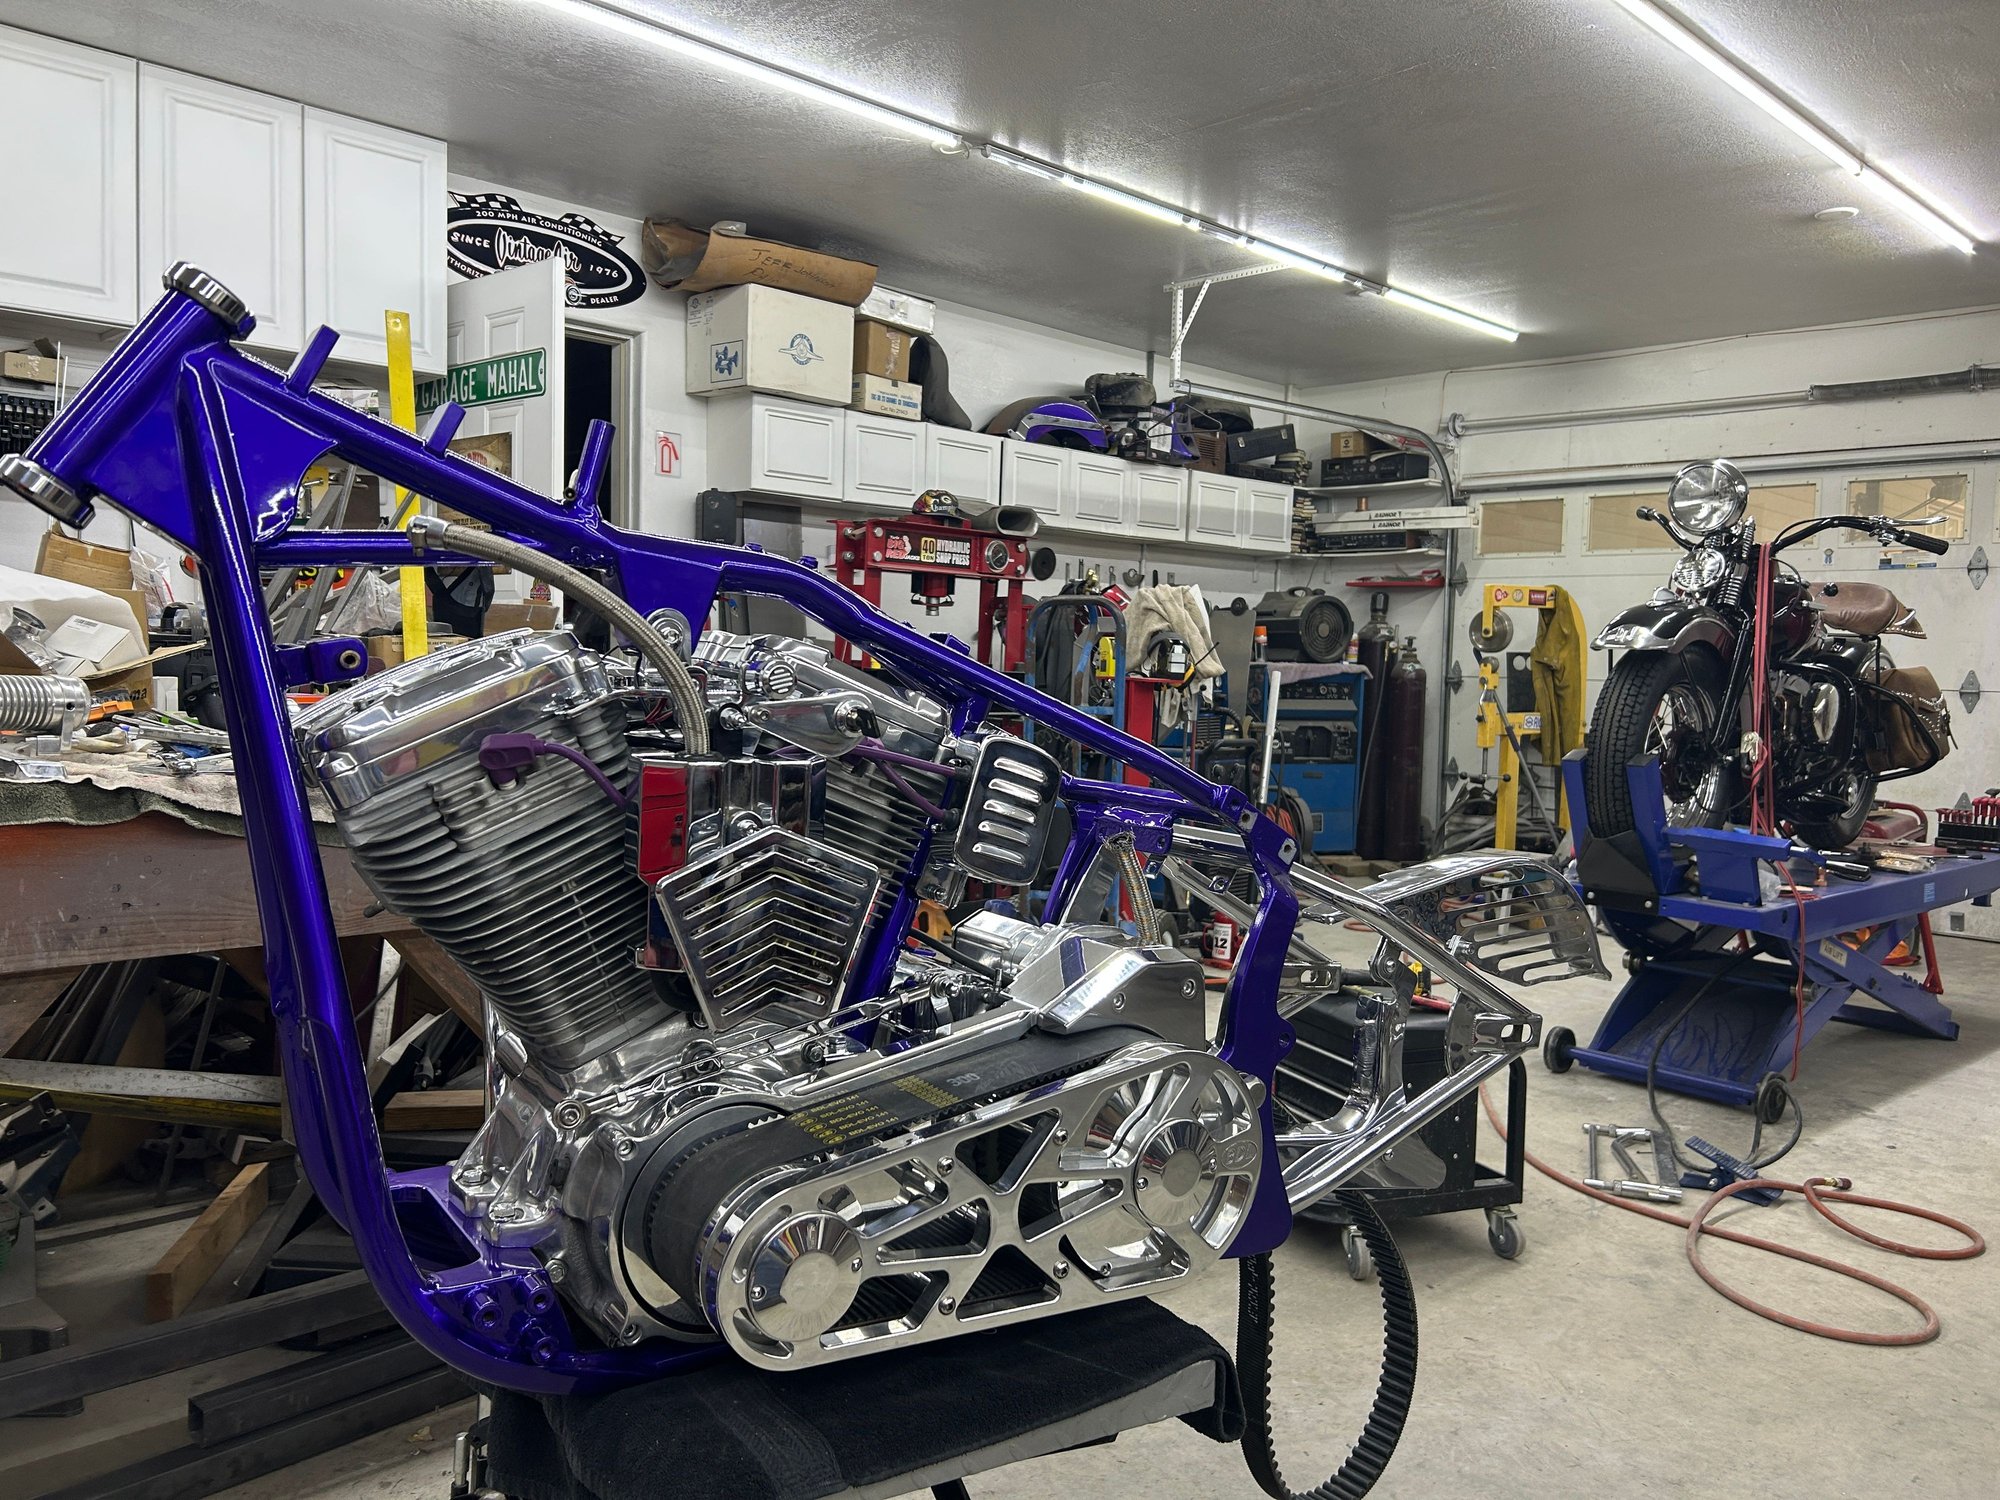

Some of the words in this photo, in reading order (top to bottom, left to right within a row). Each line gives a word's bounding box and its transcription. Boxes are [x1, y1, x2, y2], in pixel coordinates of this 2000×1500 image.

[497, 212, 518, 220] MPH
[521, 215, 537, 224] AIR
[539, 219, 603, 247] CONDITIONING
[450, 231, 491, 248] SINCE
[589, 264, 620, 278] 1976
[590, 295, 619, 305] DEALER
[421, 367, 478, 409] GARAGE
[487, 356, 537, 398] MAHAL
[922, 539, 935, 554] 40
[936, 539, 971, 555] HYDRAULIC
[935, 551, 952, 564] SHOP
[951, 553, 971, 567] PRESS
[1214, 936, 1228, 949] 12
[945, 1072, 981, 1088] 300
